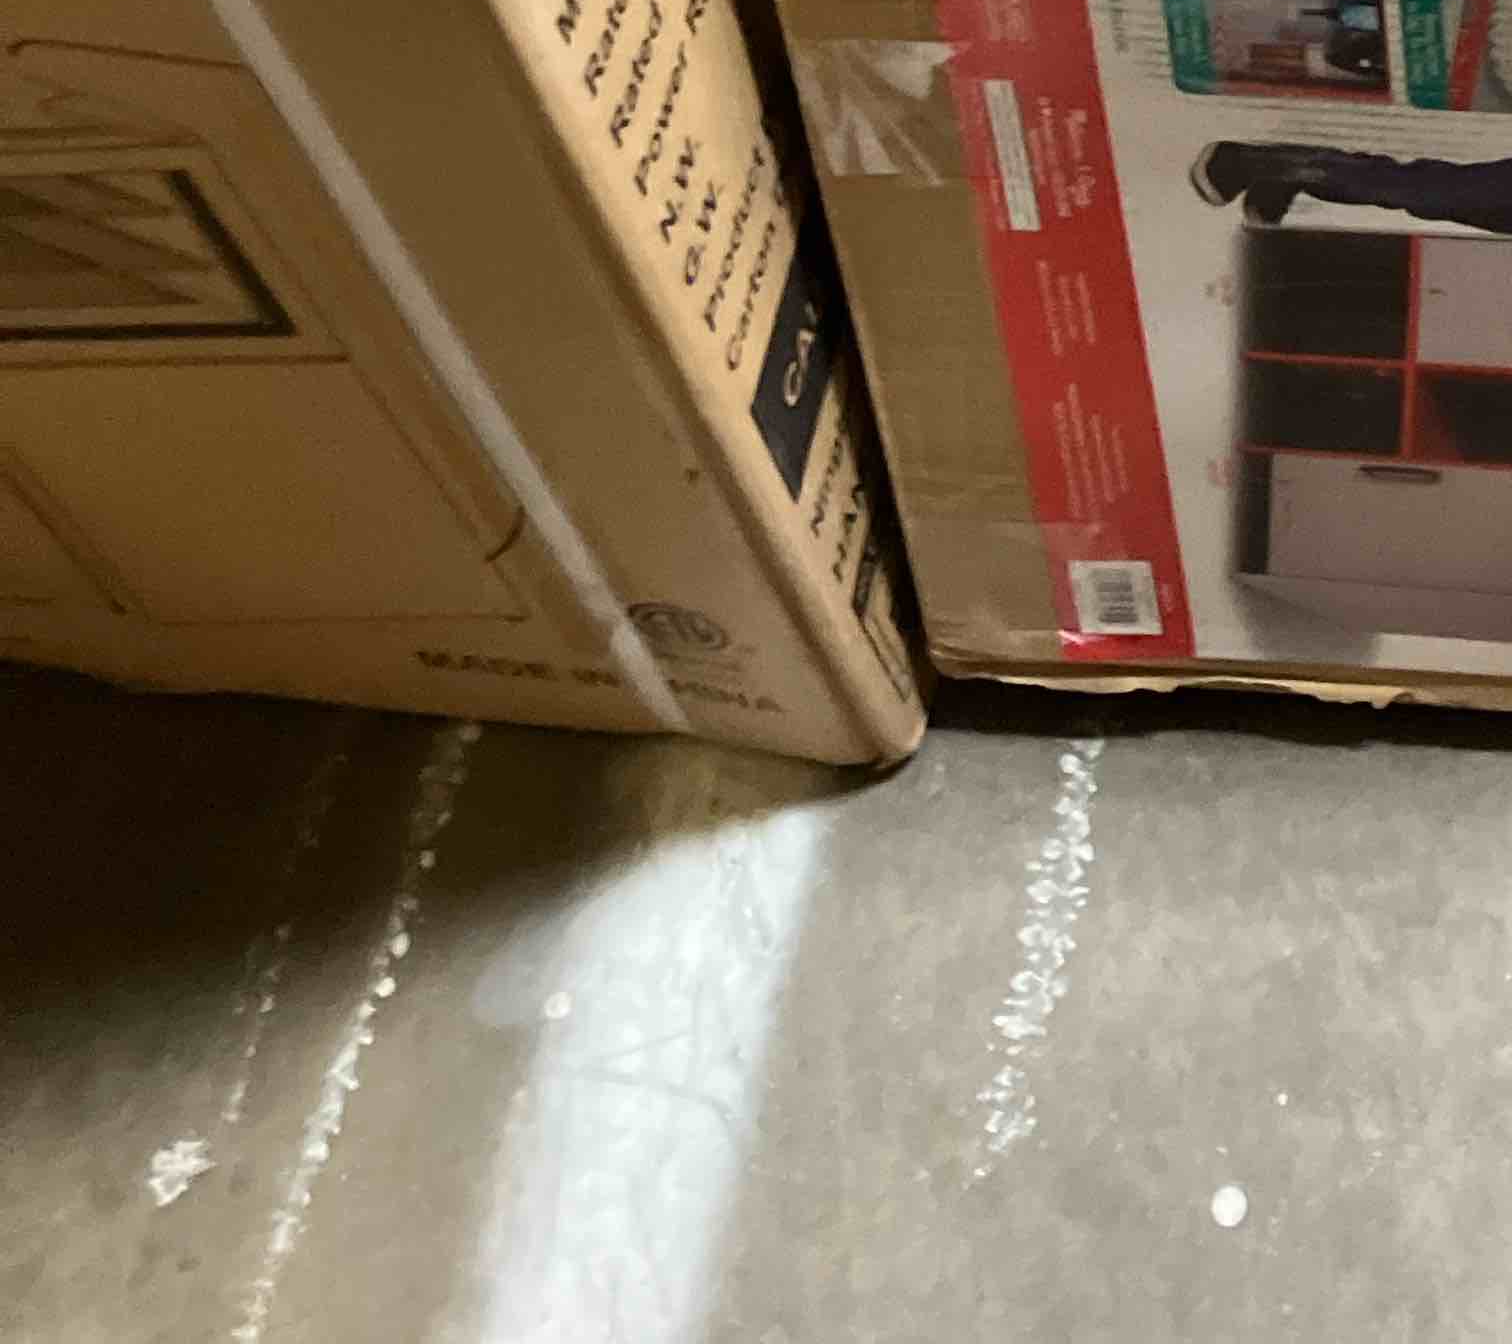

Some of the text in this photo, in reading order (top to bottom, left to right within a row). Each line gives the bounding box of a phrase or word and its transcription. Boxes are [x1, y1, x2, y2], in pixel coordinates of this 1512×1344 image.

[610, 0, 662, 149] Rated
[634, 41, 686, 197] Power
[703, 145, 766, 333] Product
[726, 218, 776, 373] Carton
